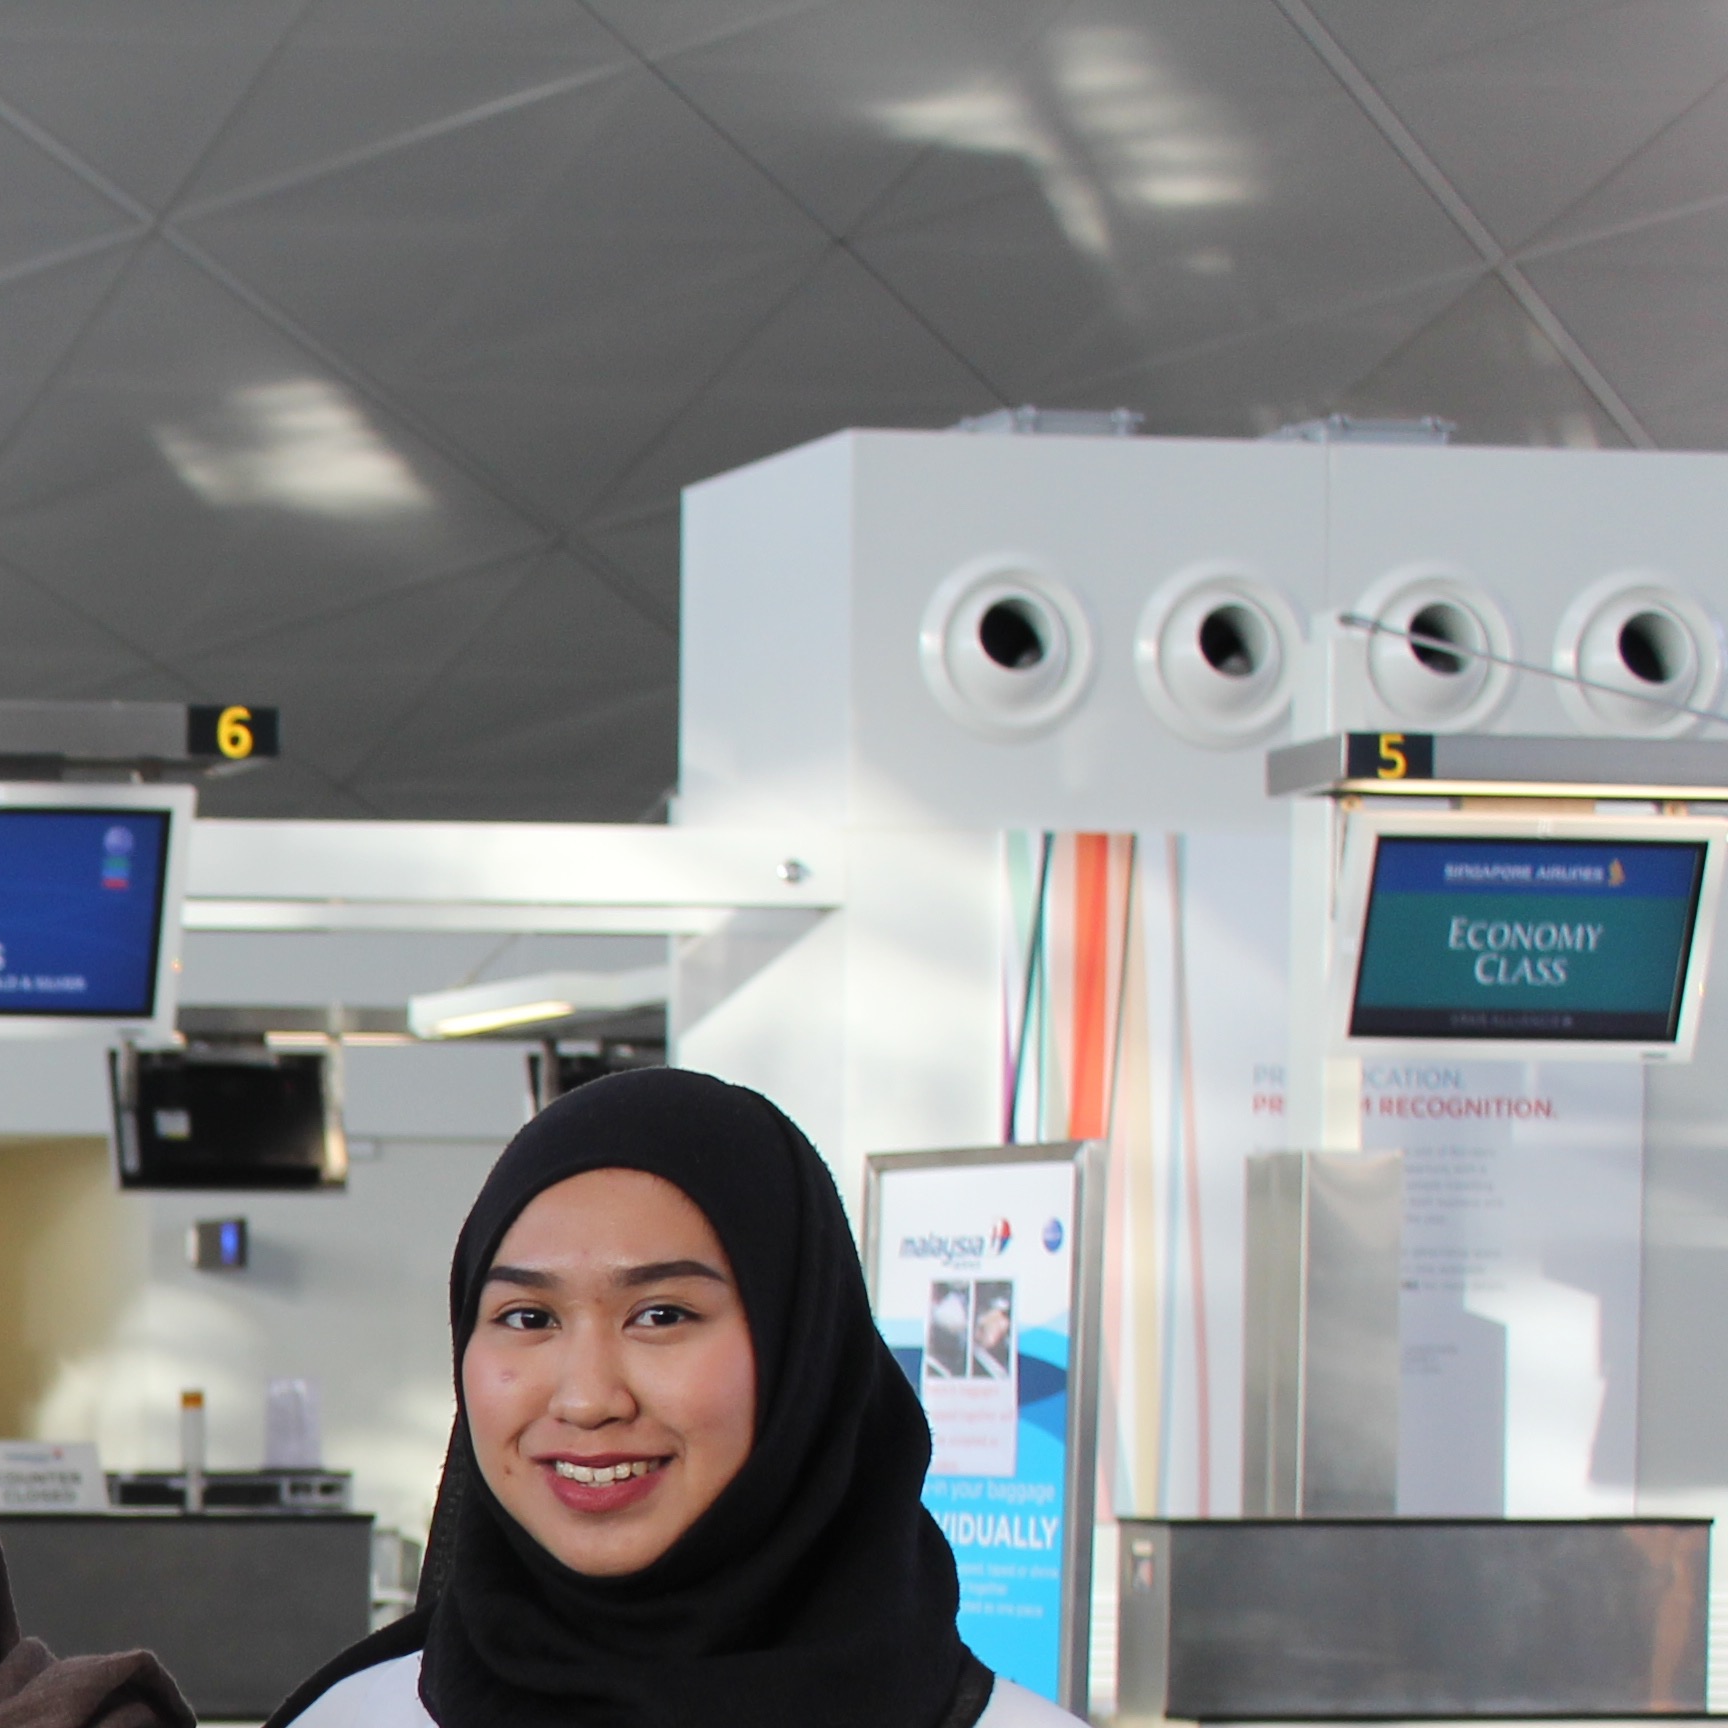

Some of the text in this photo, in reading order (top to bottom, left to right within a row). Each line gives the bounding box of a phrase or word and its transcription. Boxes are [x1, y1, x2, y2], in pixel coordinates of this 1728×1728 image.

[216, 705, 254, 759] 6
[1377, 733, 1408, 779] 5
[1445, 864, 1533, 882] SINGAPORE
[1448, 916, 1604, 952] ECONOMY
[1474, 952, 1568, 986] CLASS
